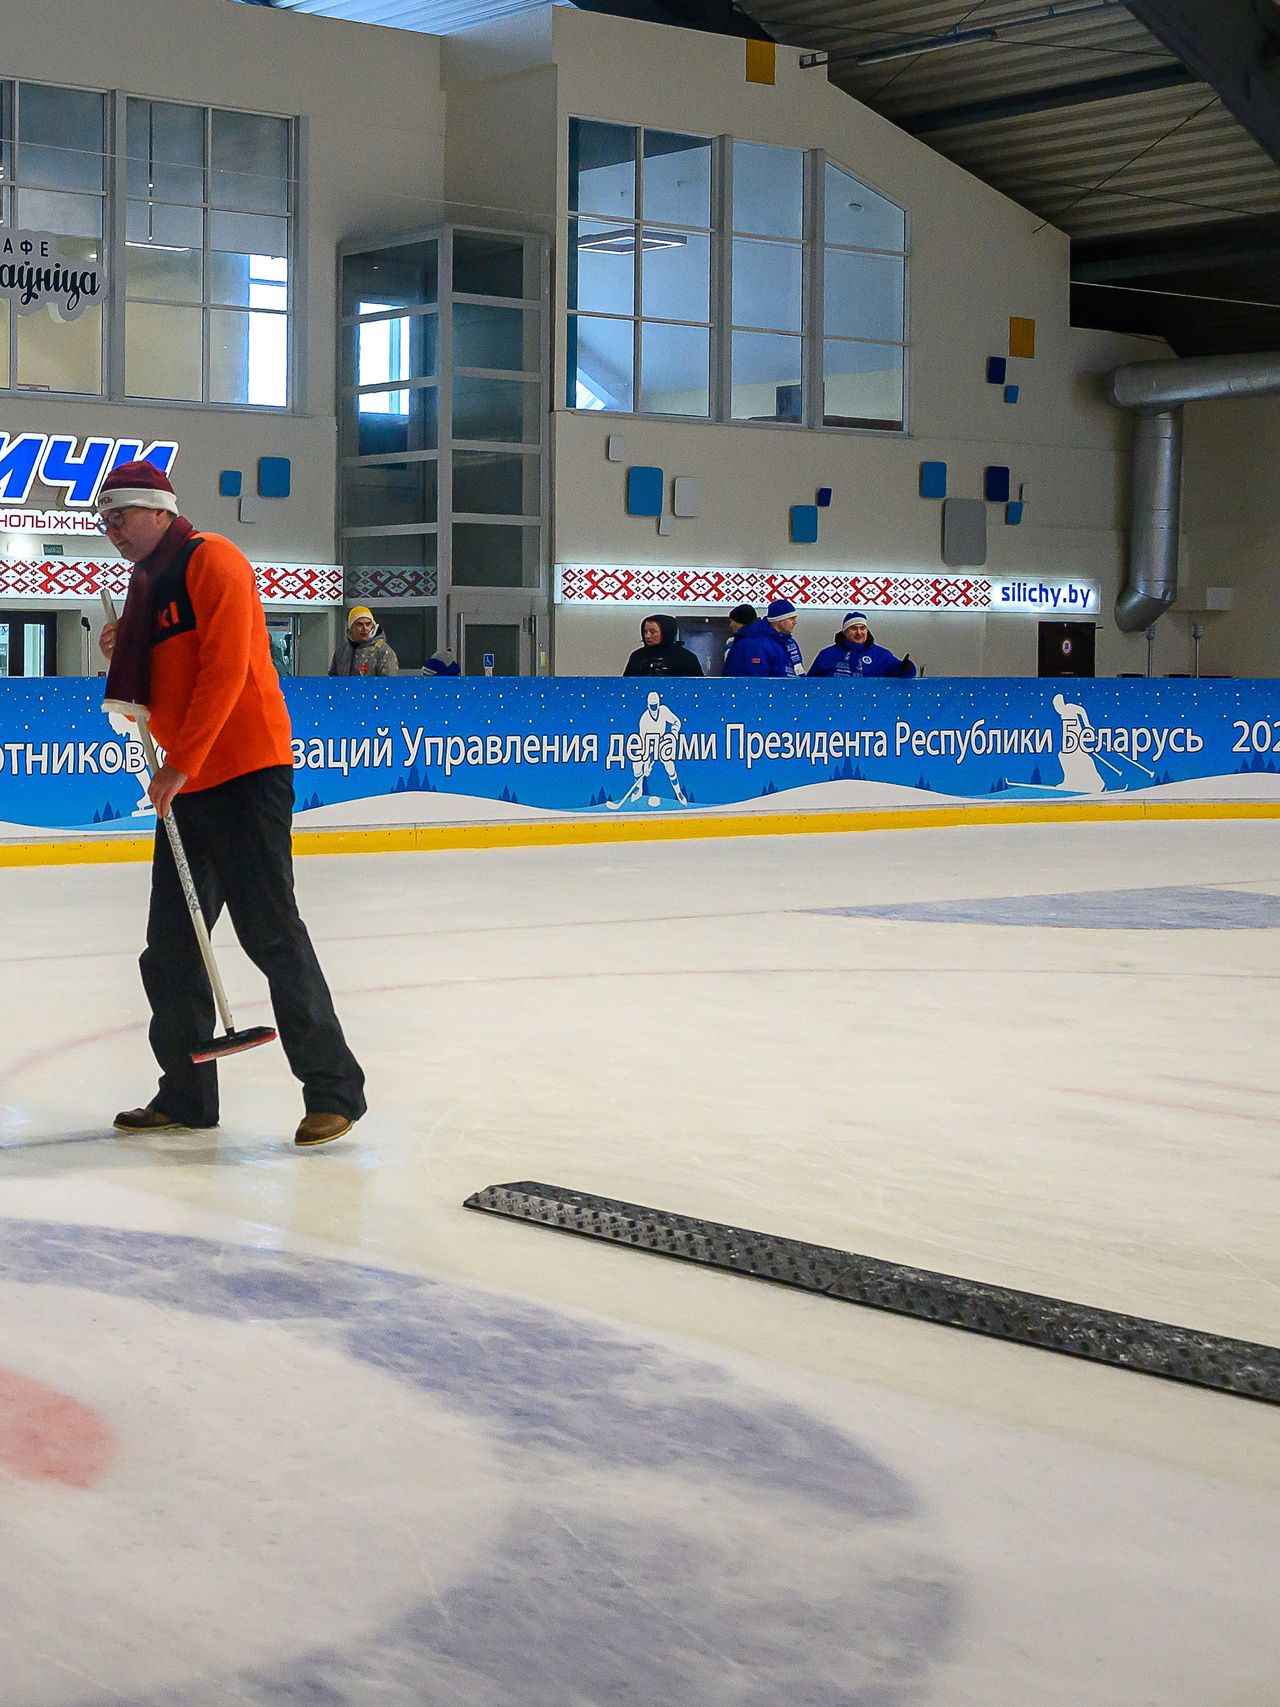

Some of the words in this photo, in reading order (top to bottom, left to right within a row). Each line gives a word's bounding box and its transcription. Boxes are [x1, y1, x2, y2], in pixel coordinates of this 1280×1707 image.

[1001, 582, 1091, 608] silichy.by
[402, 725, 599, 777] Управления
[605, 731, 718, 770] делами
[725, 722, 888, 770] Президента
[894, 718, 1053, 766] Республики
[1061, 718, 1205, 762] Беларусь
